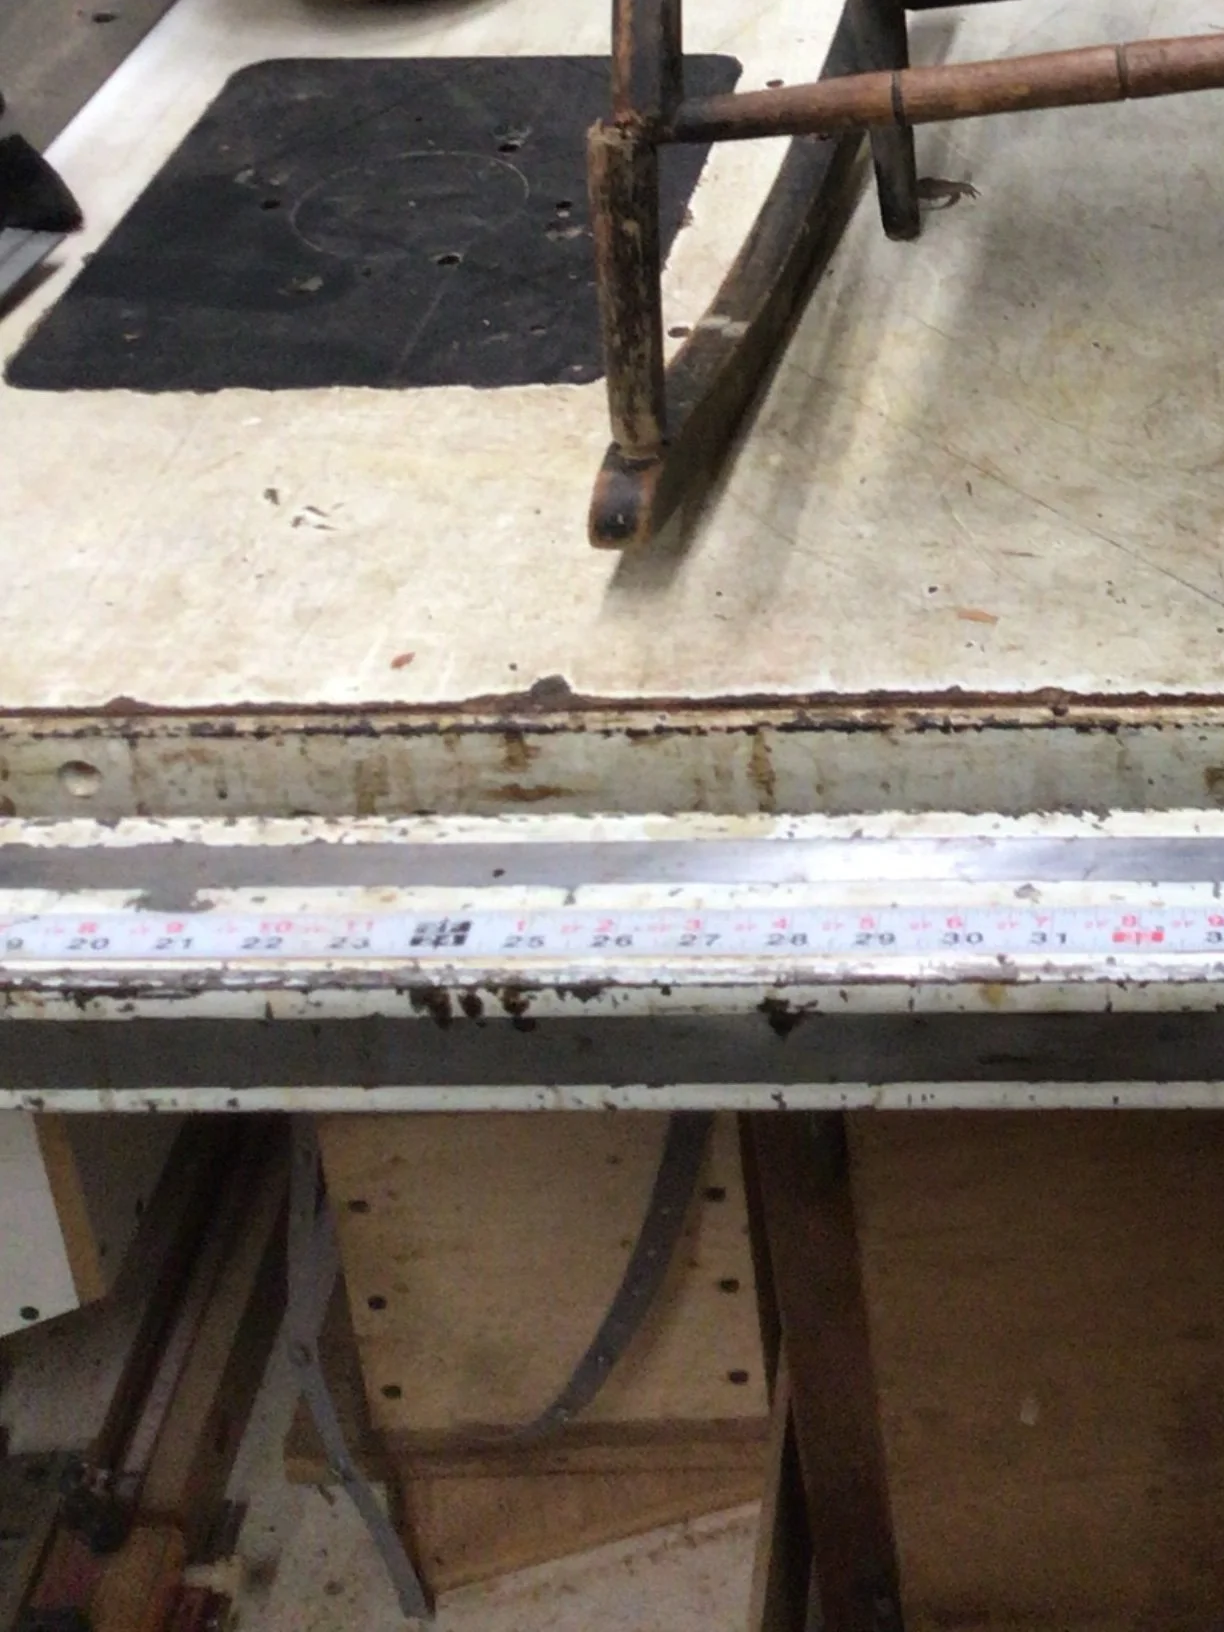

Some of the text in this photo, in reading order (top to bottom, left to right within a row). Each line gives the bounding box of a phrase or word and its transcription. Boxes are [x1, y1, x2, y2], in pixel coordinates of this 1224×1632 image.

[66, 937, 109, 949] 20
[155, 937, 193, 949] 21
[241, 936, 283, 949] 22
[503, 935, 545, 948] 25
[591, 934, 632, 947] 26
[679, 934, 720, 946] 27
[766, 933, 808, 946] 28
[855, 933, 895, 946] 29
[943, 932, 983, 944] 30
[1030, 932, 1066, 944] 31
